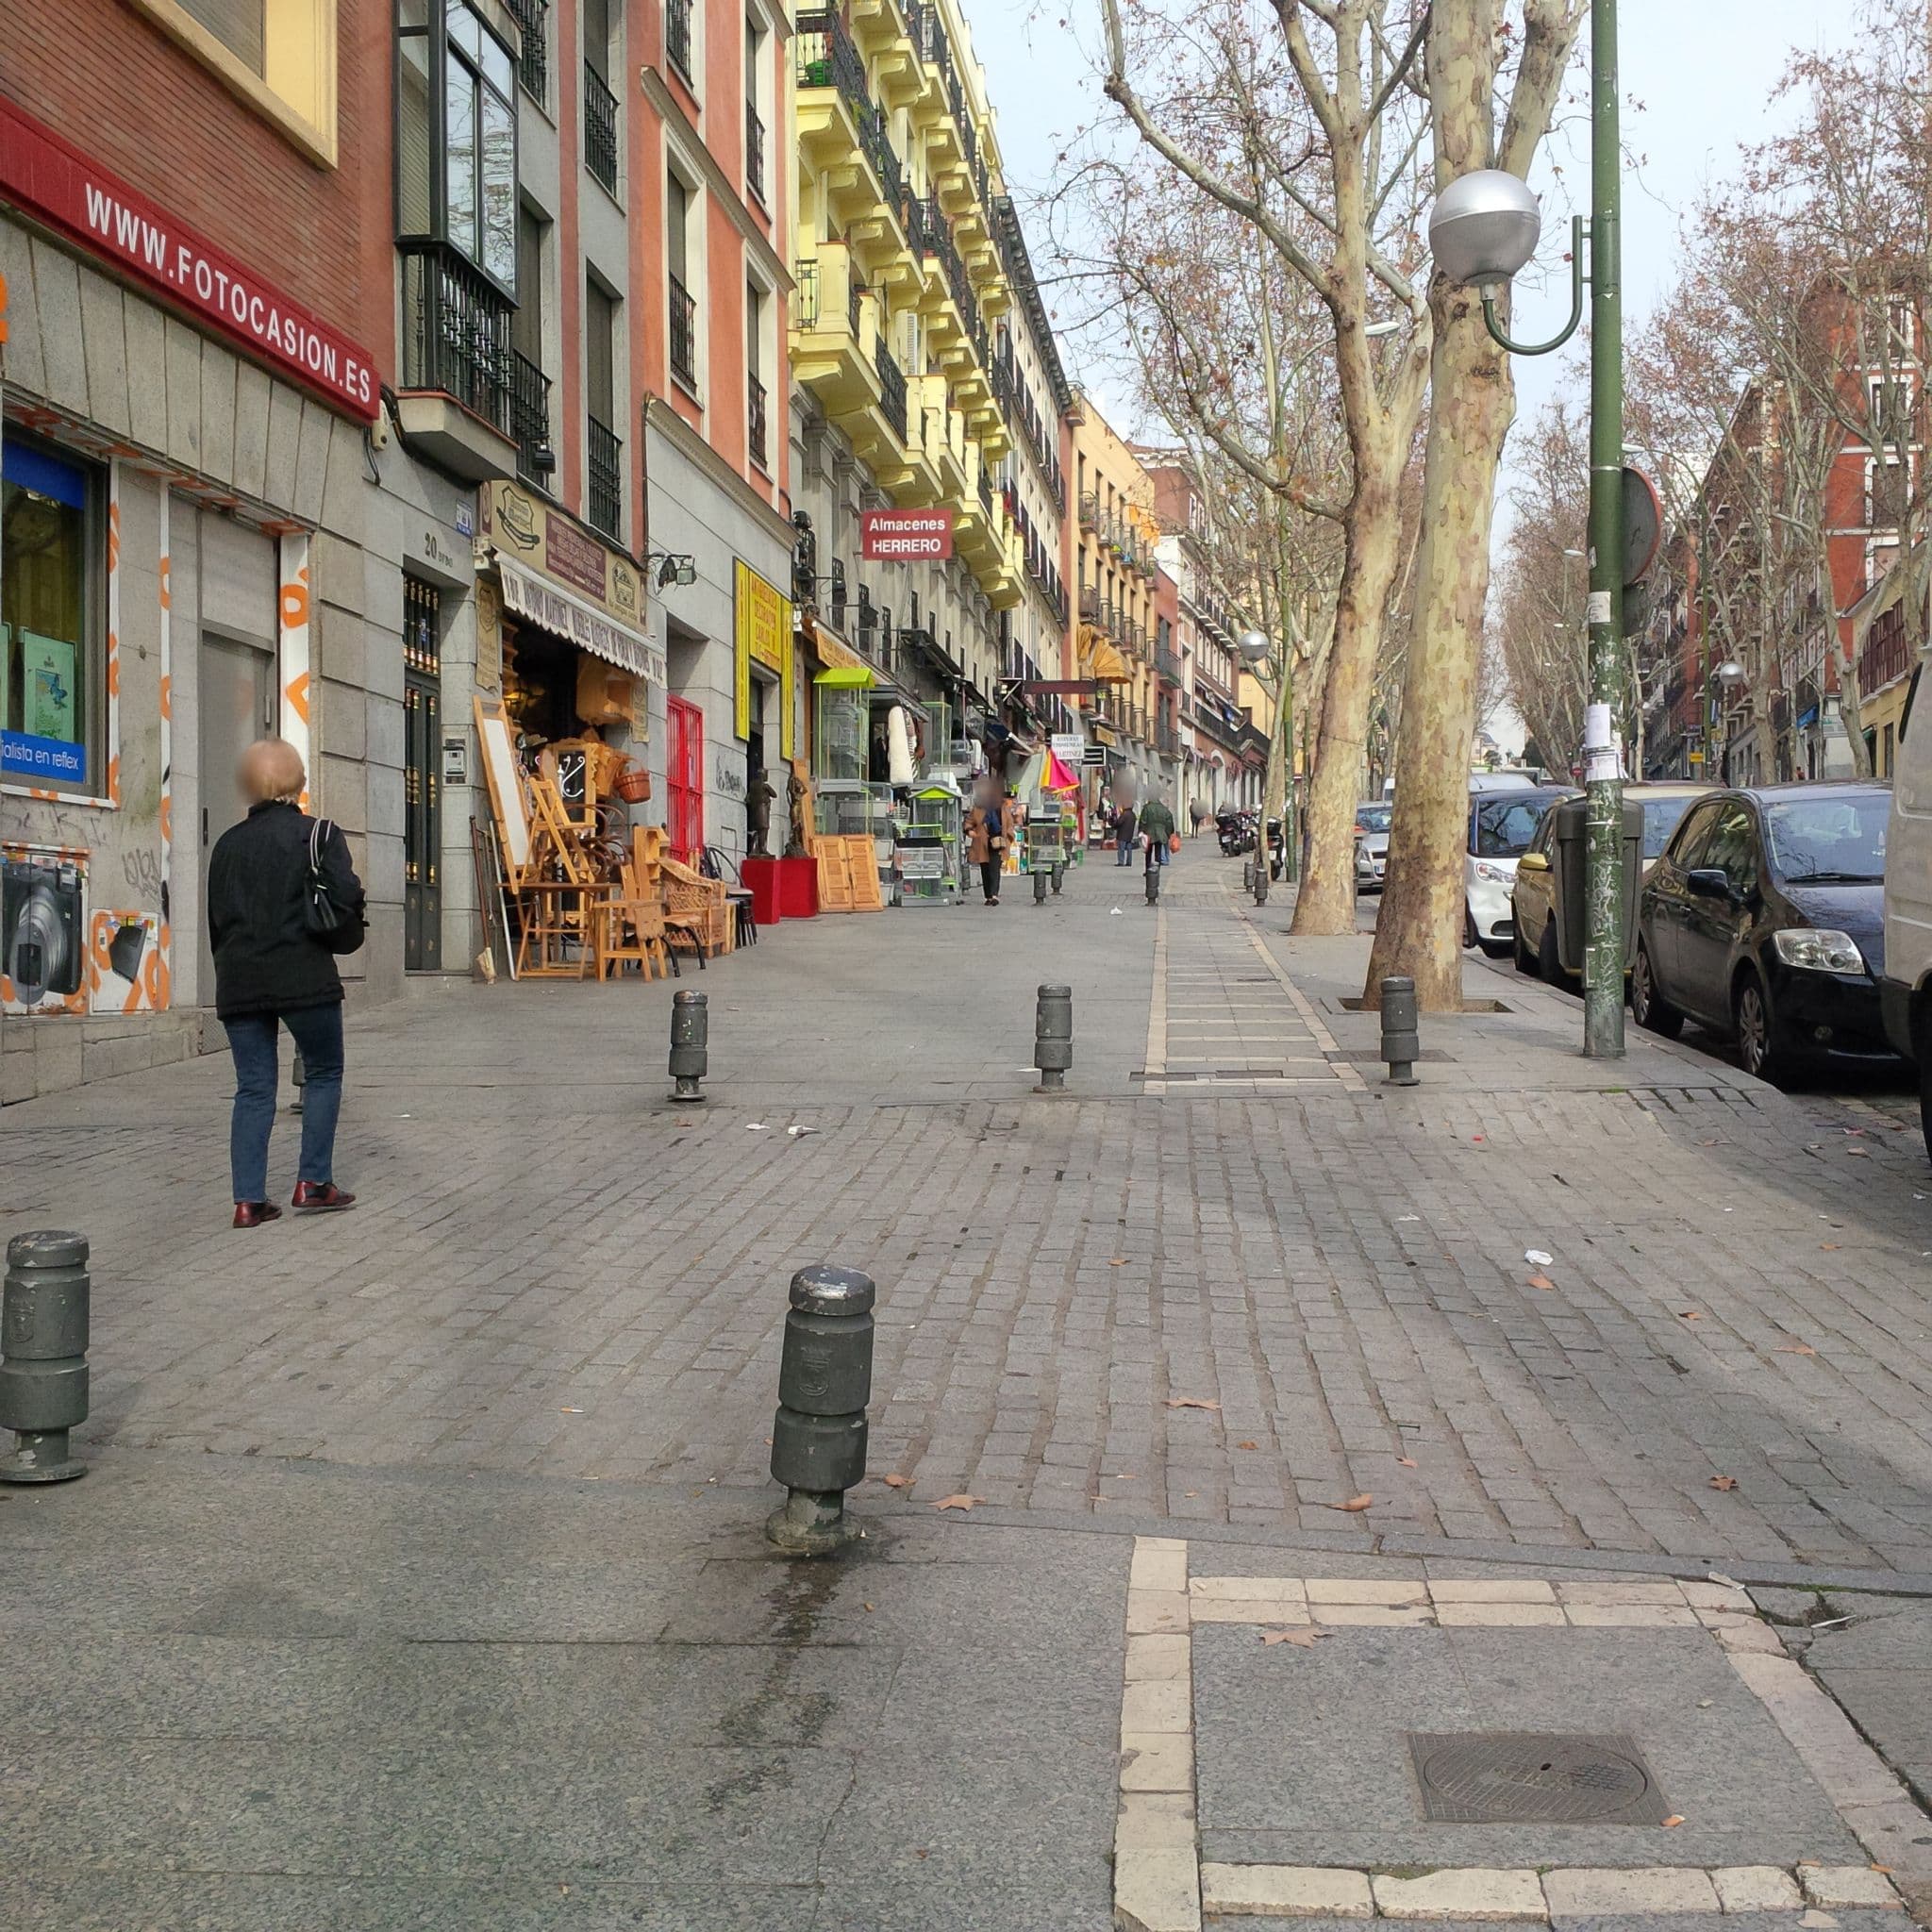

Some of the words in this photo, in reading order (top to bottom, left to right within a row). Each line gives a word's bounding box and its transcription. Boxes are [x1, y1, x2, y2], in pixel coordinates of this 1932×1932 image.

[85, 181, 371, 403] WWW.FOTOCASION.ES
[869, 517, 946, 532] Almacenes
[425, 532, 438, 559] 20
[872, 538, 941, 554] HERRERO
[35, 750, 50, 765] en
[52, 751, 79, 771] reflex
